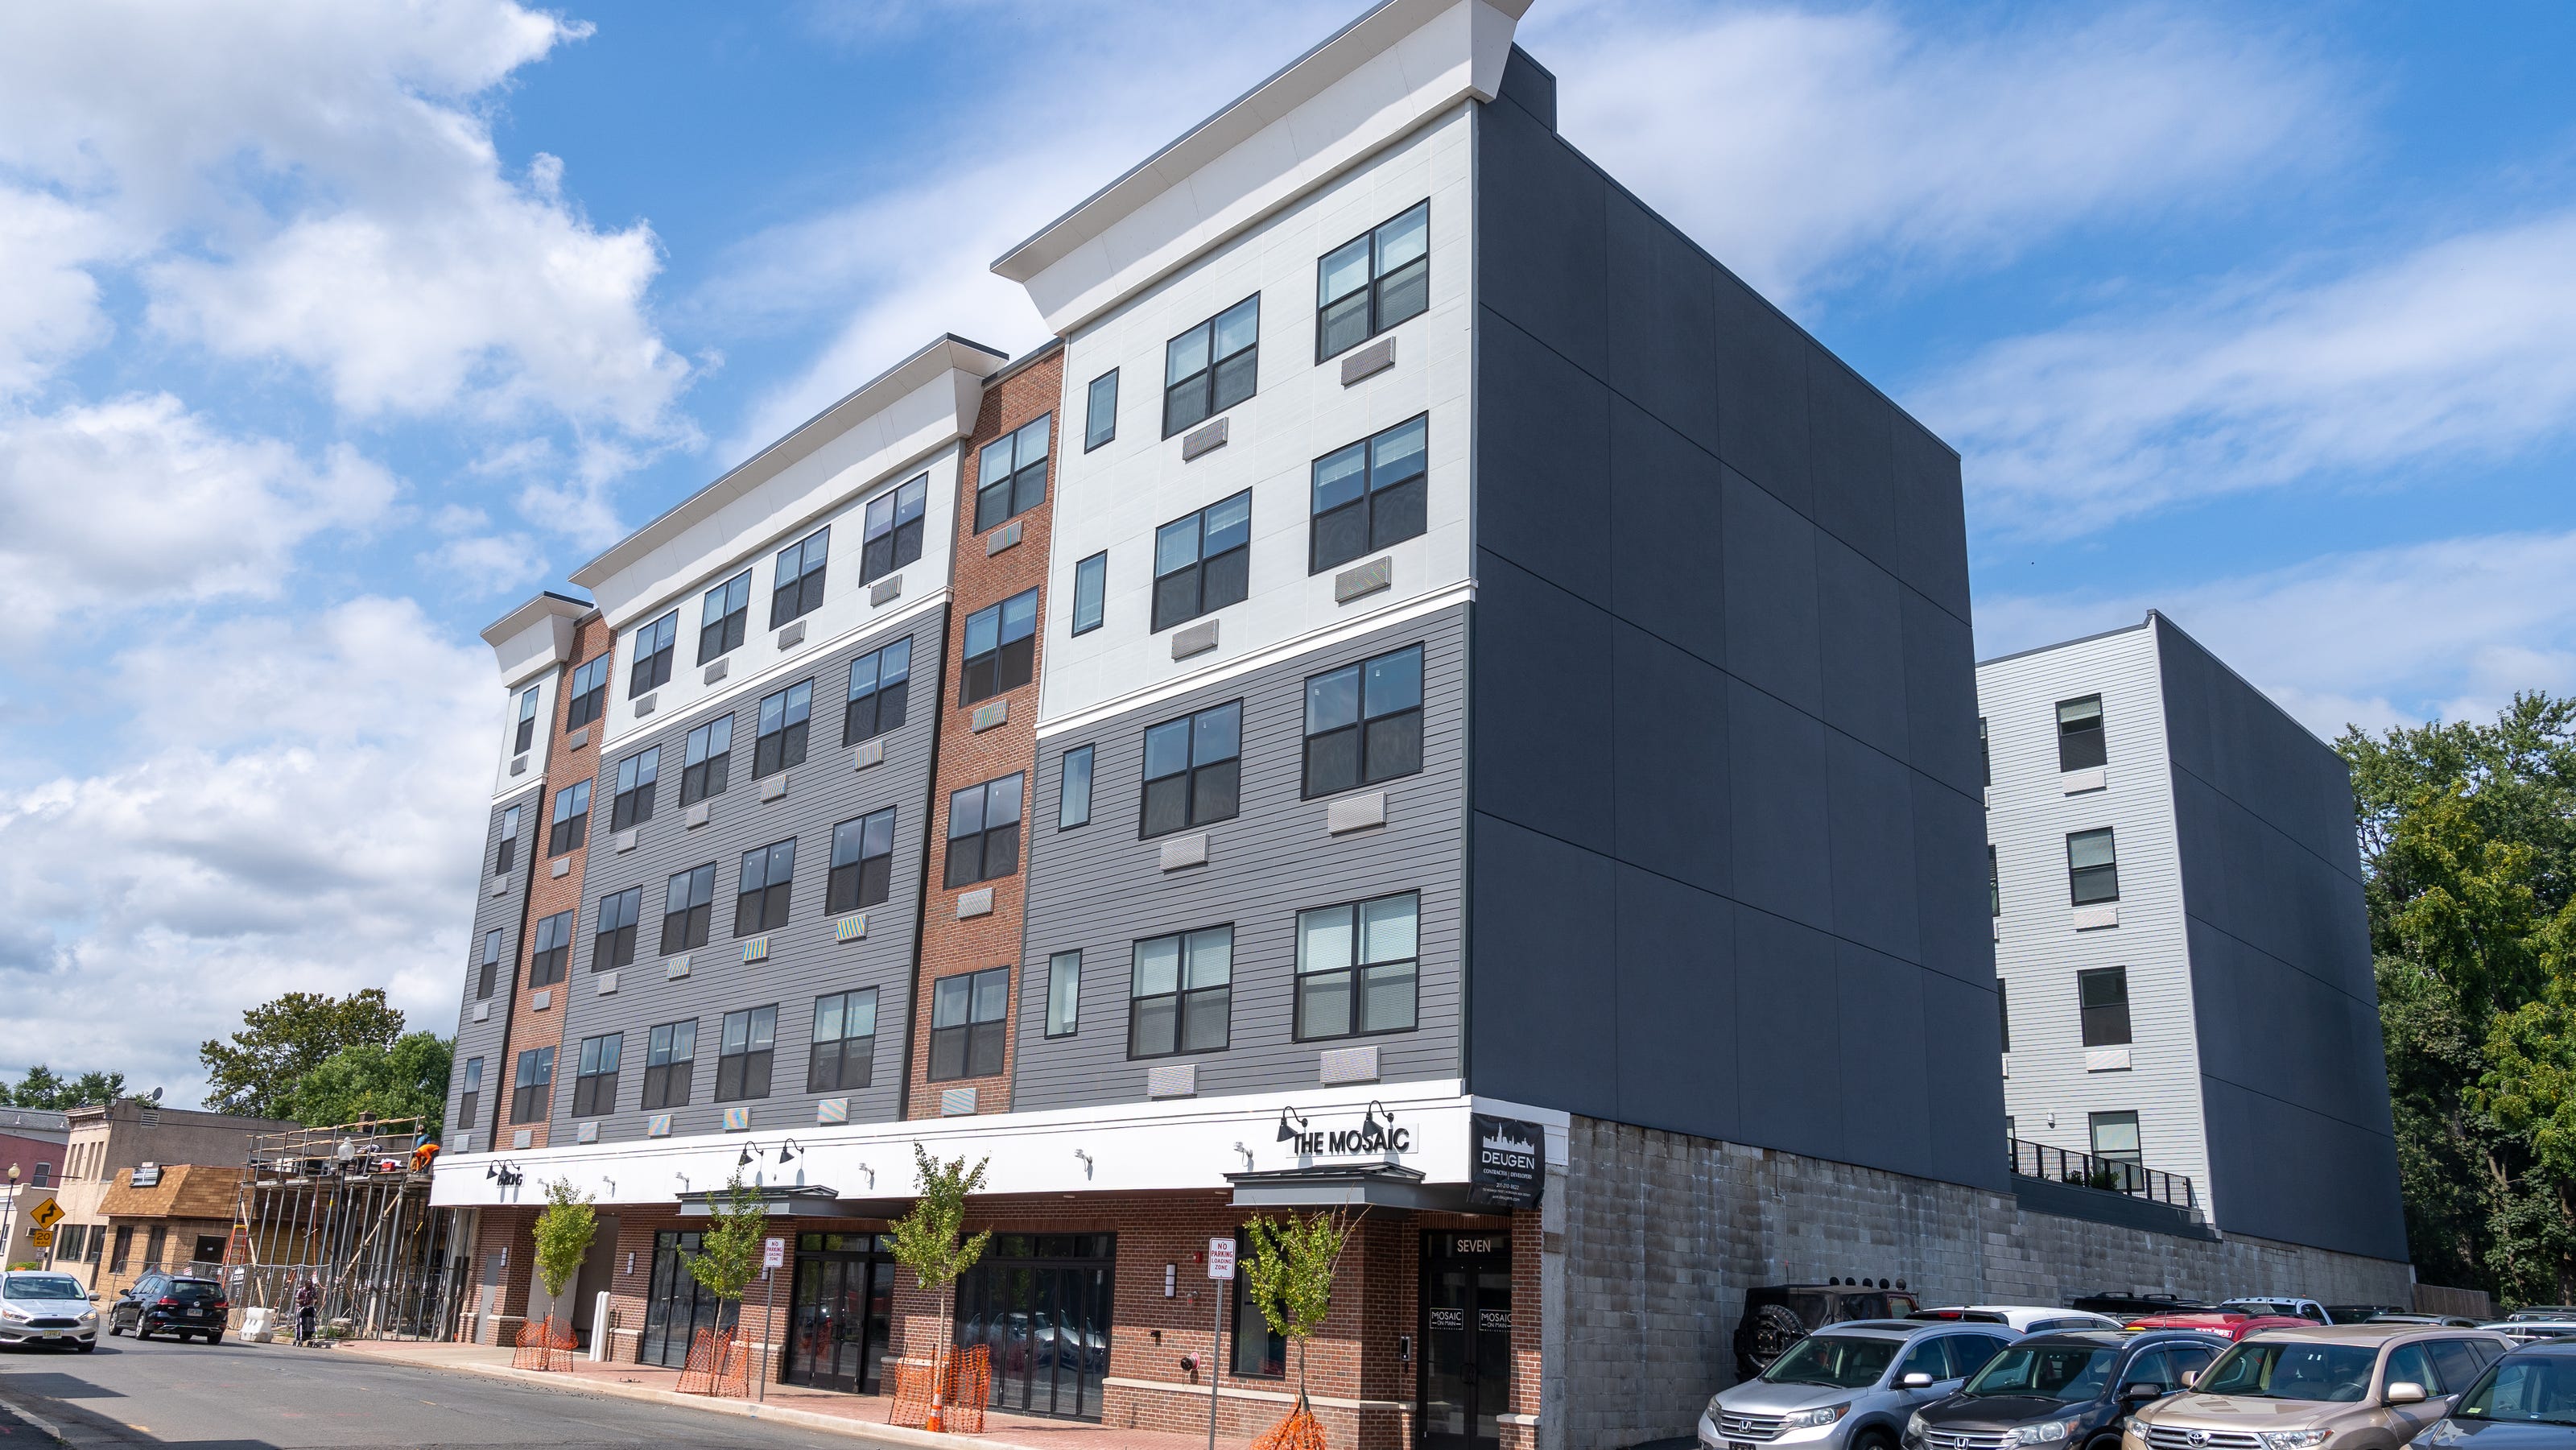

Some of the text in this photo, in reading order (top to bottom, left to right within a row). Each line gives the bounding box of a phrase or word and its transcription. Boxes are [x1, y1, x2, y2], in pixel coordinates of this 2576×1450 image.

[1294, 1128, 1410, 1155] THE MOSAIC
[1482, 1150, 1534, 1169] DEUGEN
[1457, 1239, 1490, 1252] SEVEN
[1431, 1312, 1461, 1320] MOSAIC
